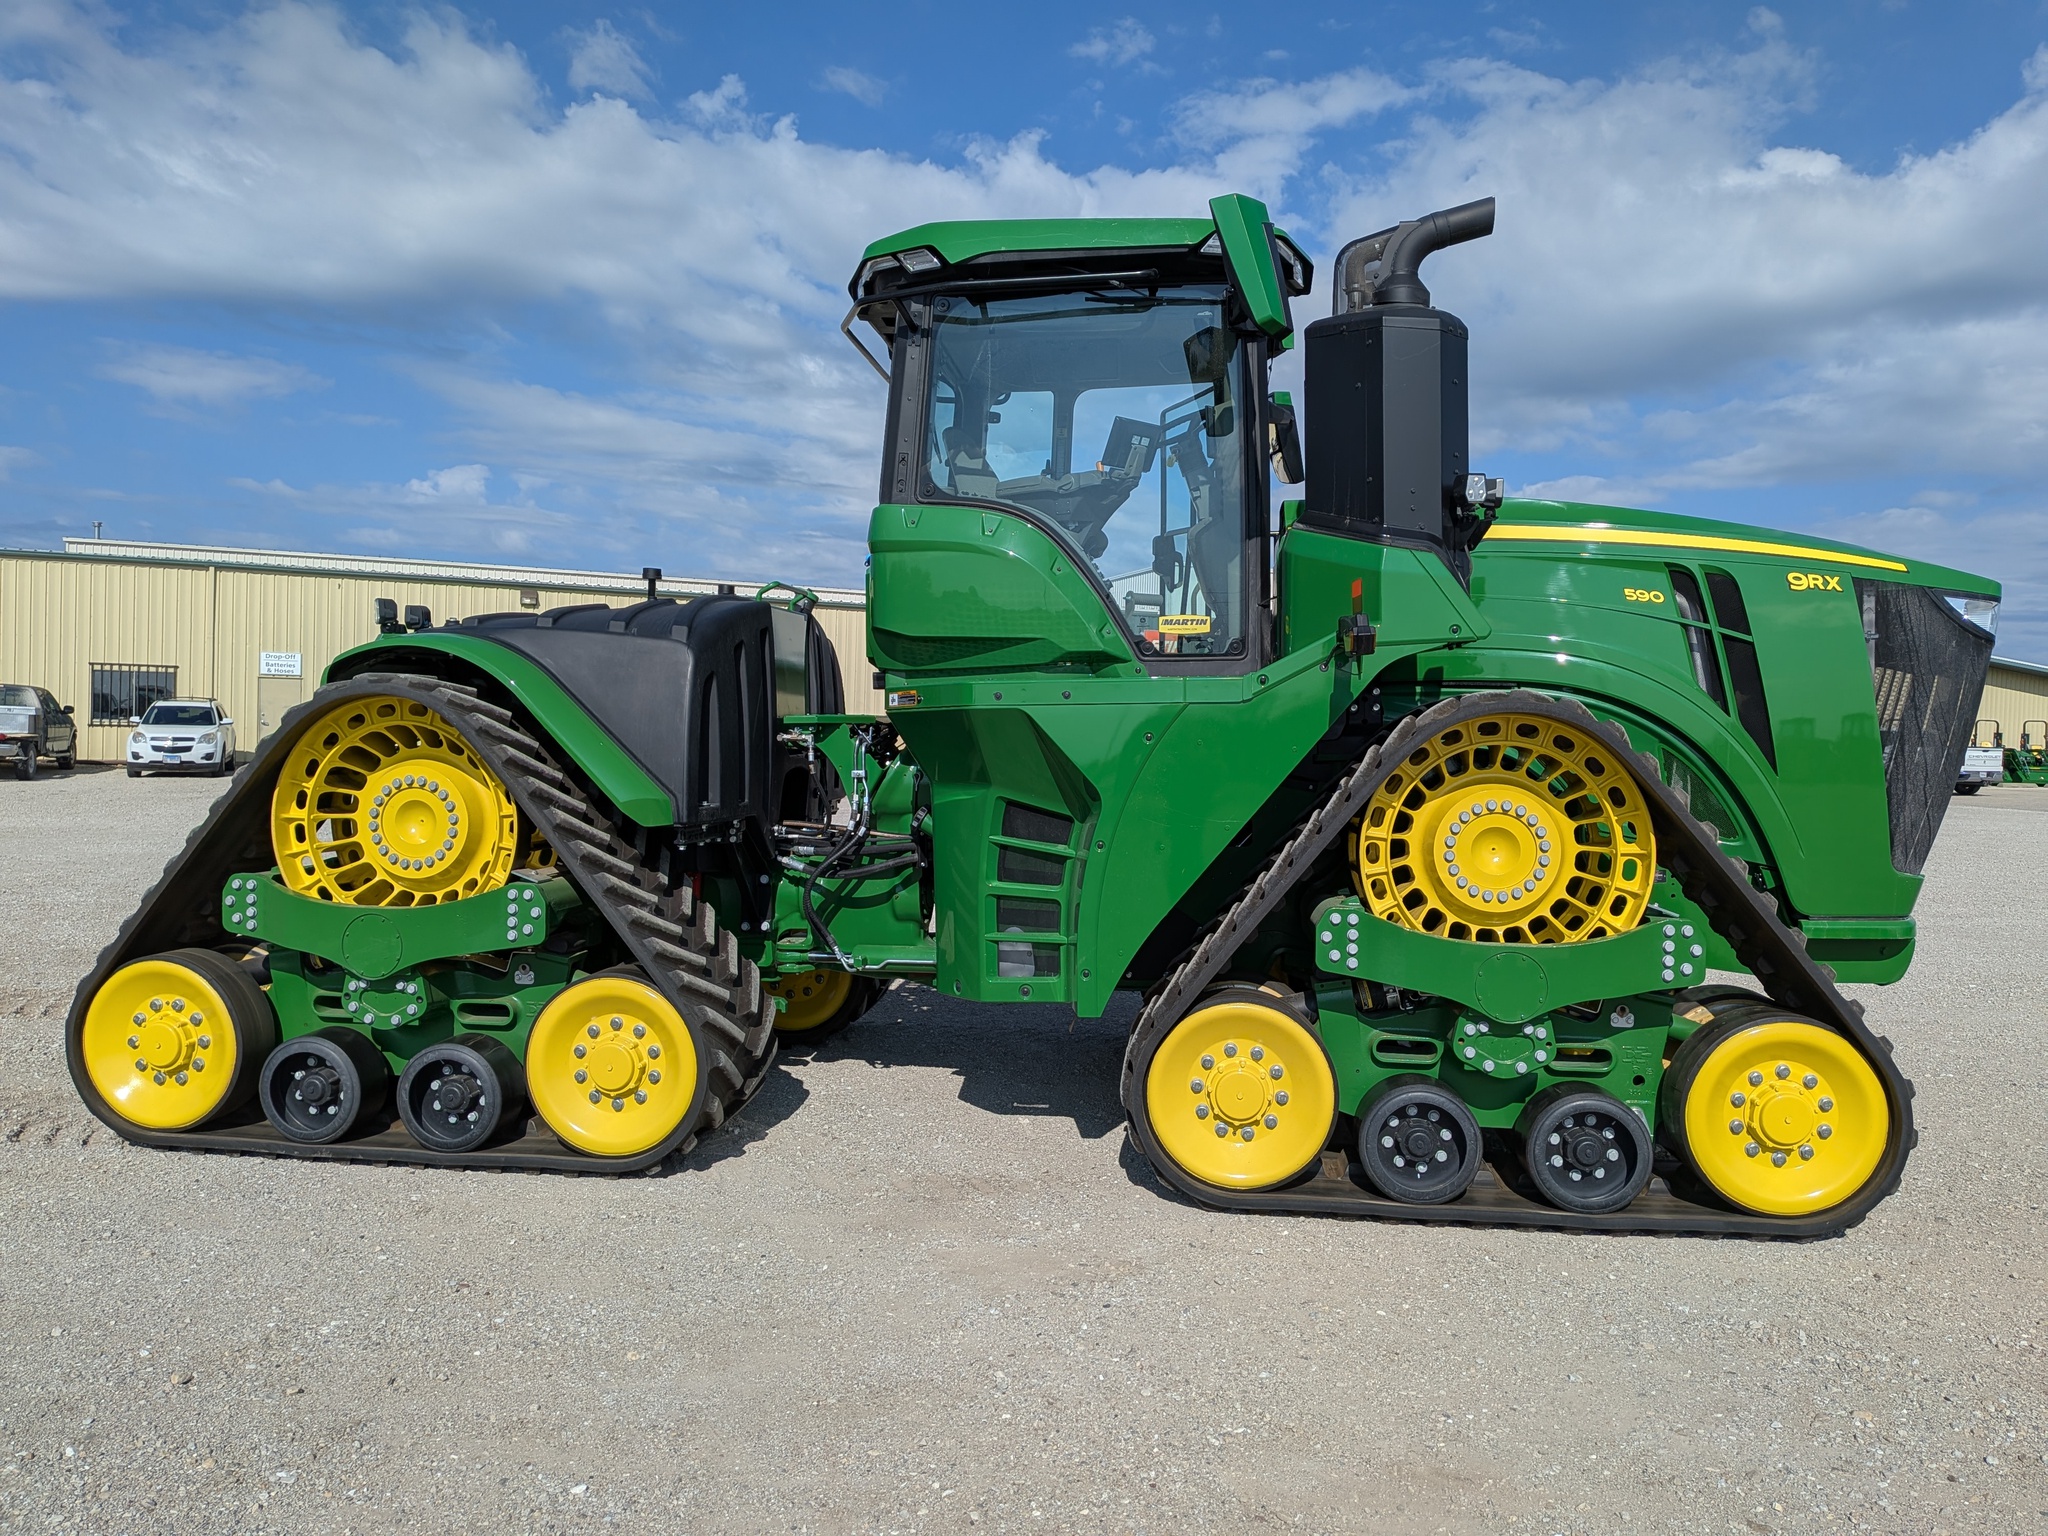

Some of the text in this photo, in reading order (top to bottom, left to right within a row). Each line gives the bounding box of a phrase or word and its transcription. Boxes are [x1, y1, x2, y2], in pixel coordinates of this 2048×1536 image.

[1786, 571, 1844, 592] 9RX
[1623, 587, 1666, 604] 590
[1162, 618, 1208, 626] MARTIN
